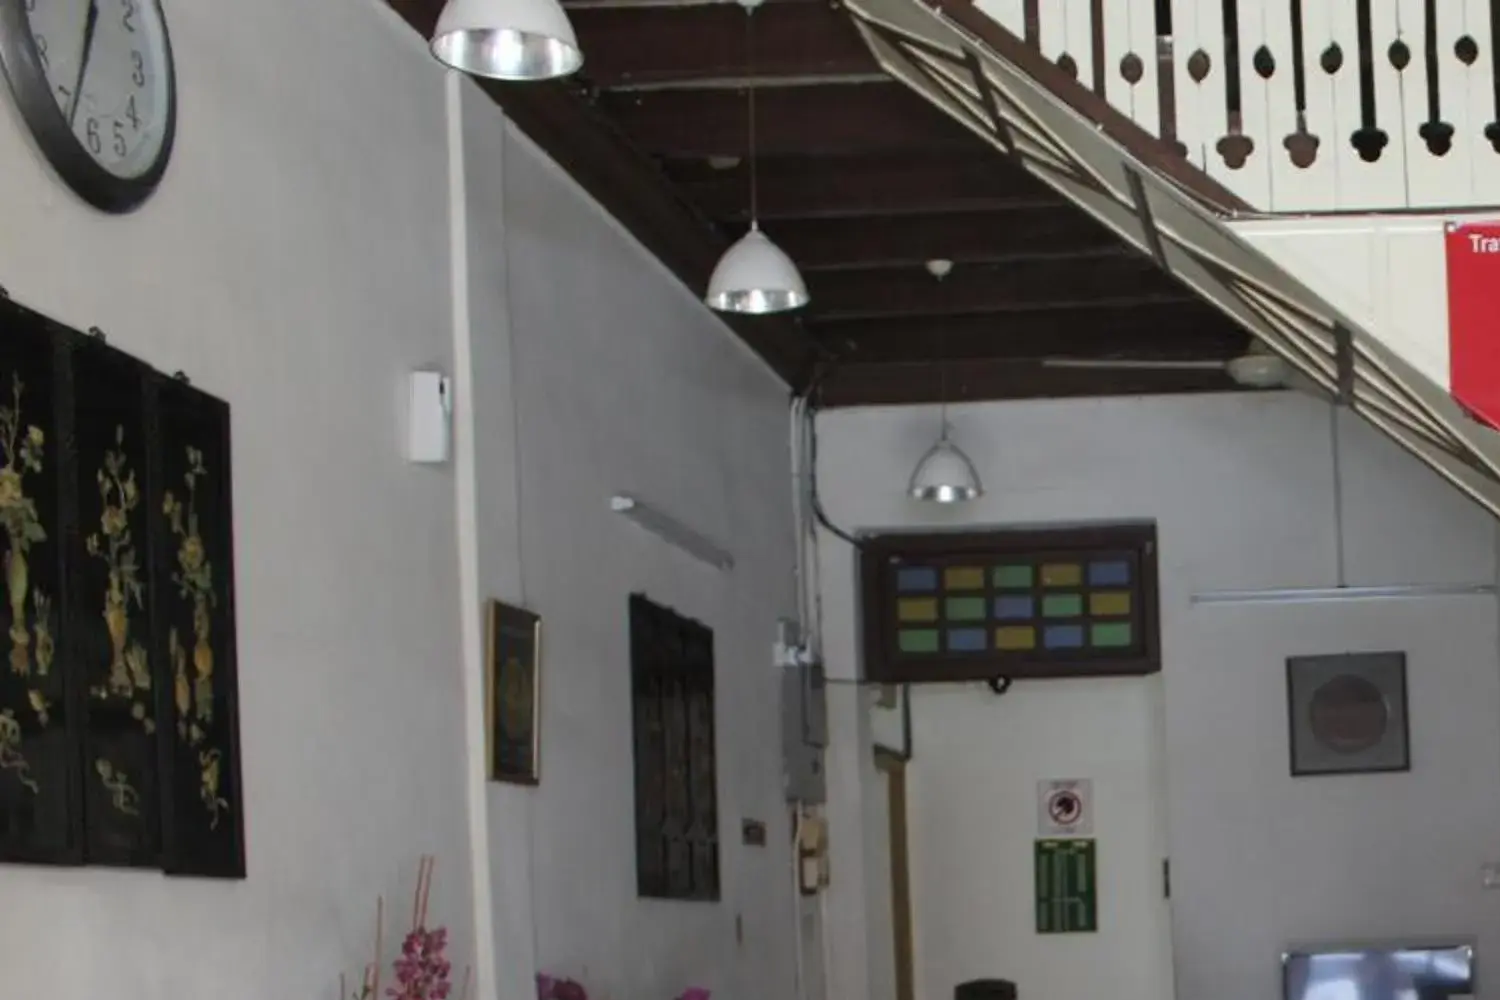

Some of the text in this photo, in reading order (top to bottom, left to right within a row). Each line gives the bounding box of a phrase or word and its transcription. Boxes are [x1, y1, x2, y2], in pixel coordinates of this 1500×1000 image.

[131, 50, 146, 89] 3
[126, 95, 139, 132] 4
[86, 117, 102, 156] 6
[112, 121, 127, 158] 5
